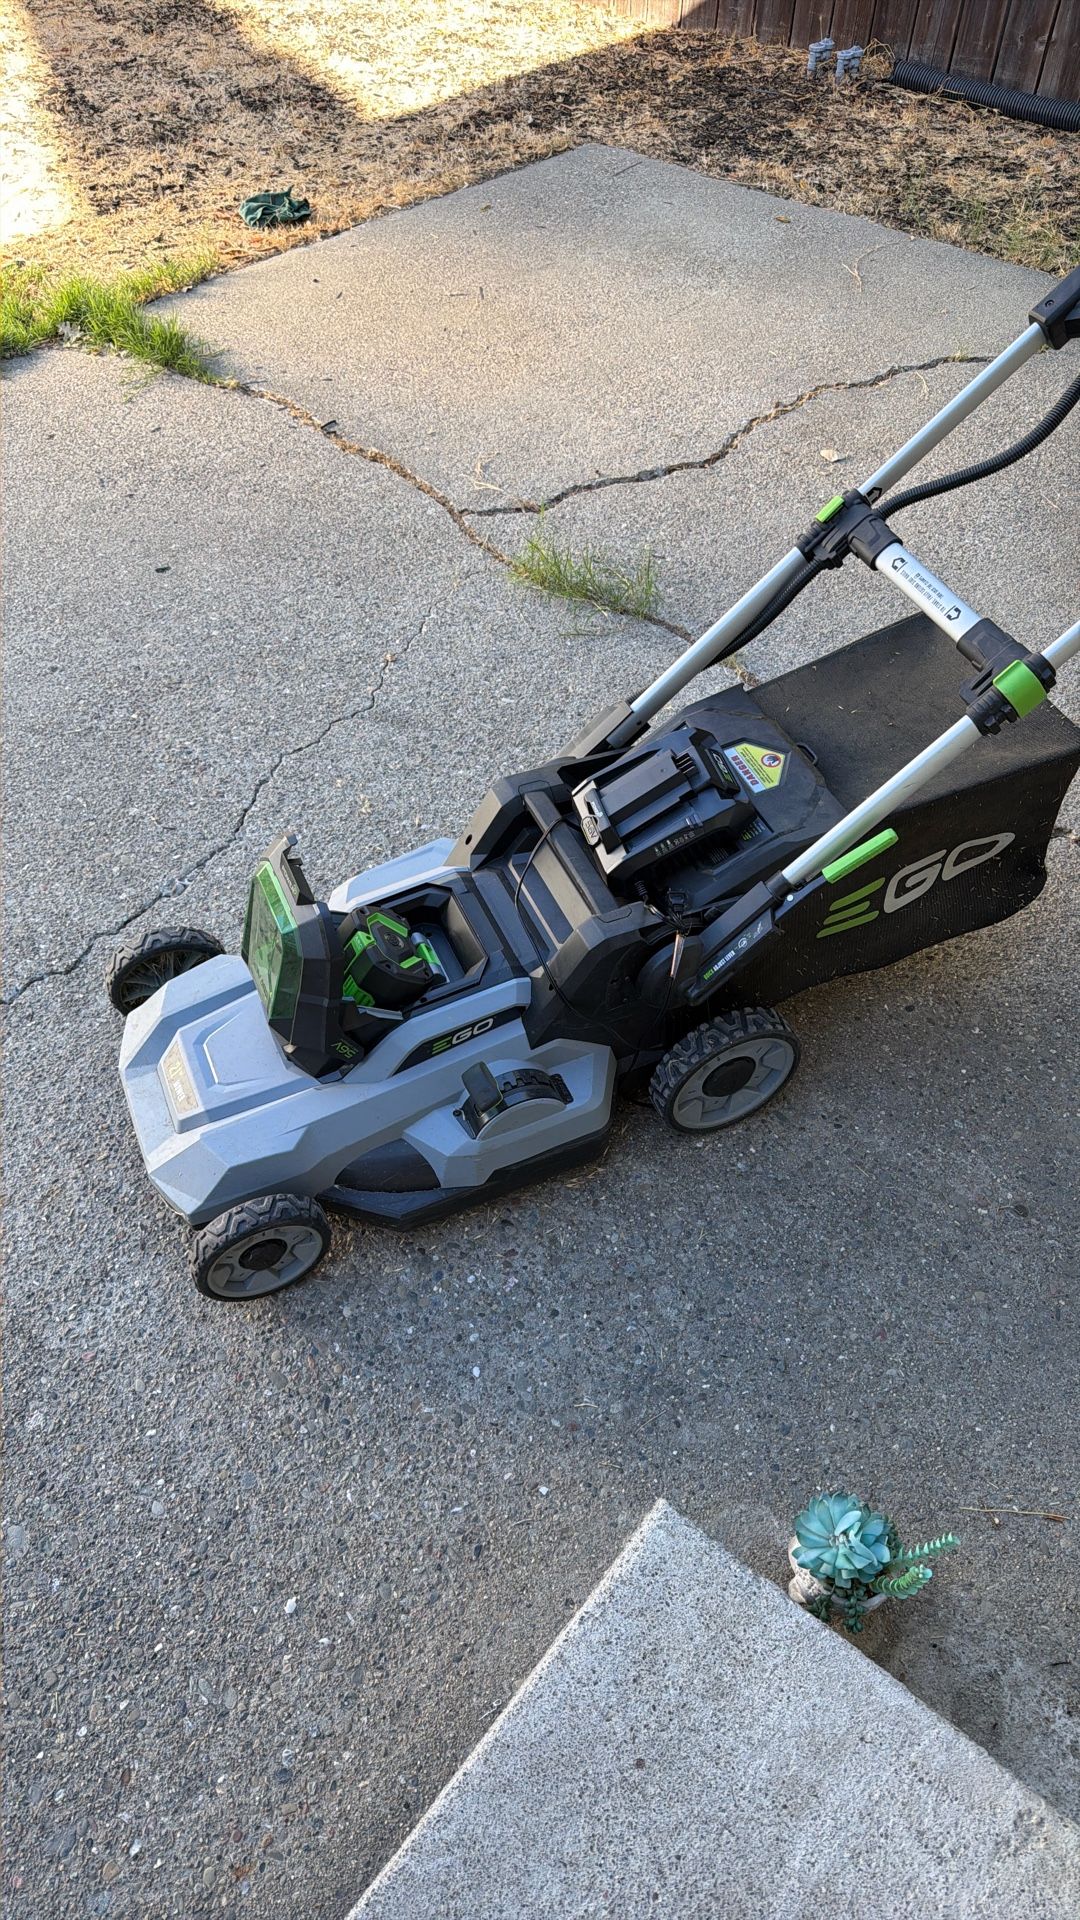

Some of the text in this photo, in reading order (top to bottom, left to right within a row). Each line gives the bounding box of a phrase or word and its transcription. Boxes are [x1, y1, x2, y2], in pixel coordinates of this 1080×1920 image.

[731, 754, 759, 785] DANGER
[816, 832, 1016, 939] EGO
[330, 1042, 357, 1059] 56V
[431, 1017, 494, 1055] EGO
